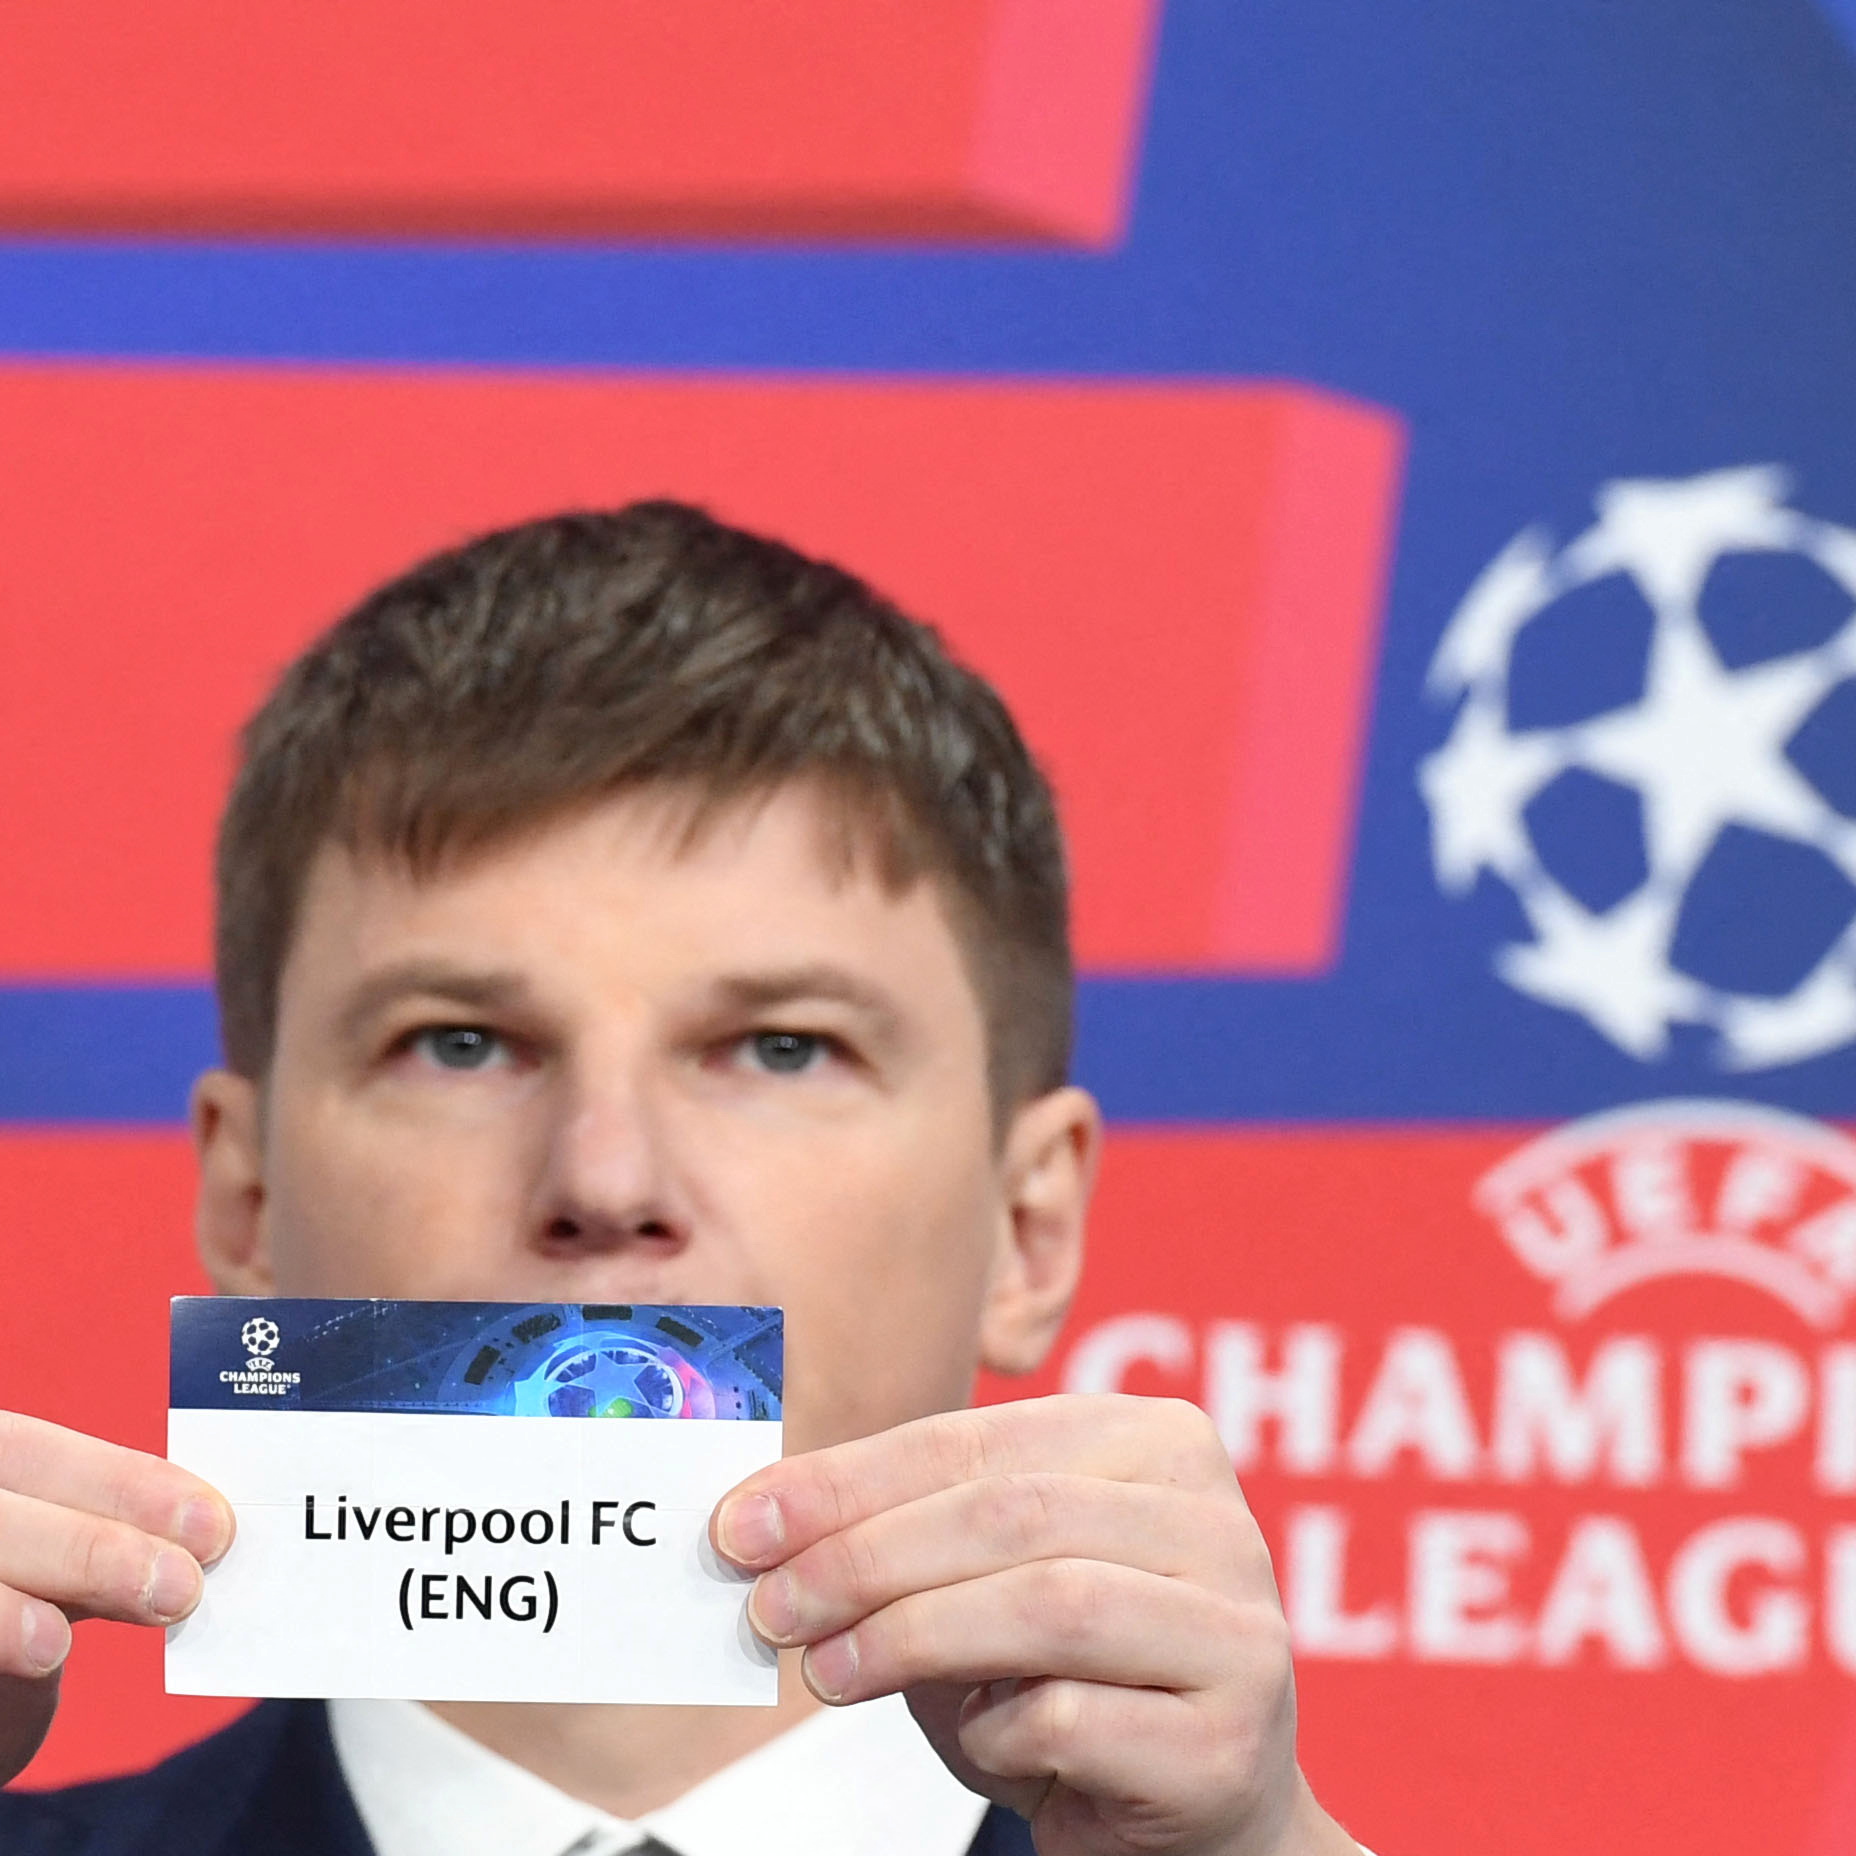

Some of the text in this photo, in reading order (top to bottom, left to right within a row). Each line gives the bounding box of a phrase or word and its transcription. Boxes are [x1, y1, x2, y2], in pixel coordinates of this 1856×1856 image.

[219, 1370, 301, 1384] CHAMPIONS
[233, 1383, 287, 1395] LEAGUE
[305, 1495, 657, 1555] Liverpool FC
[399, 1568, 559, 1634] (ENG)
